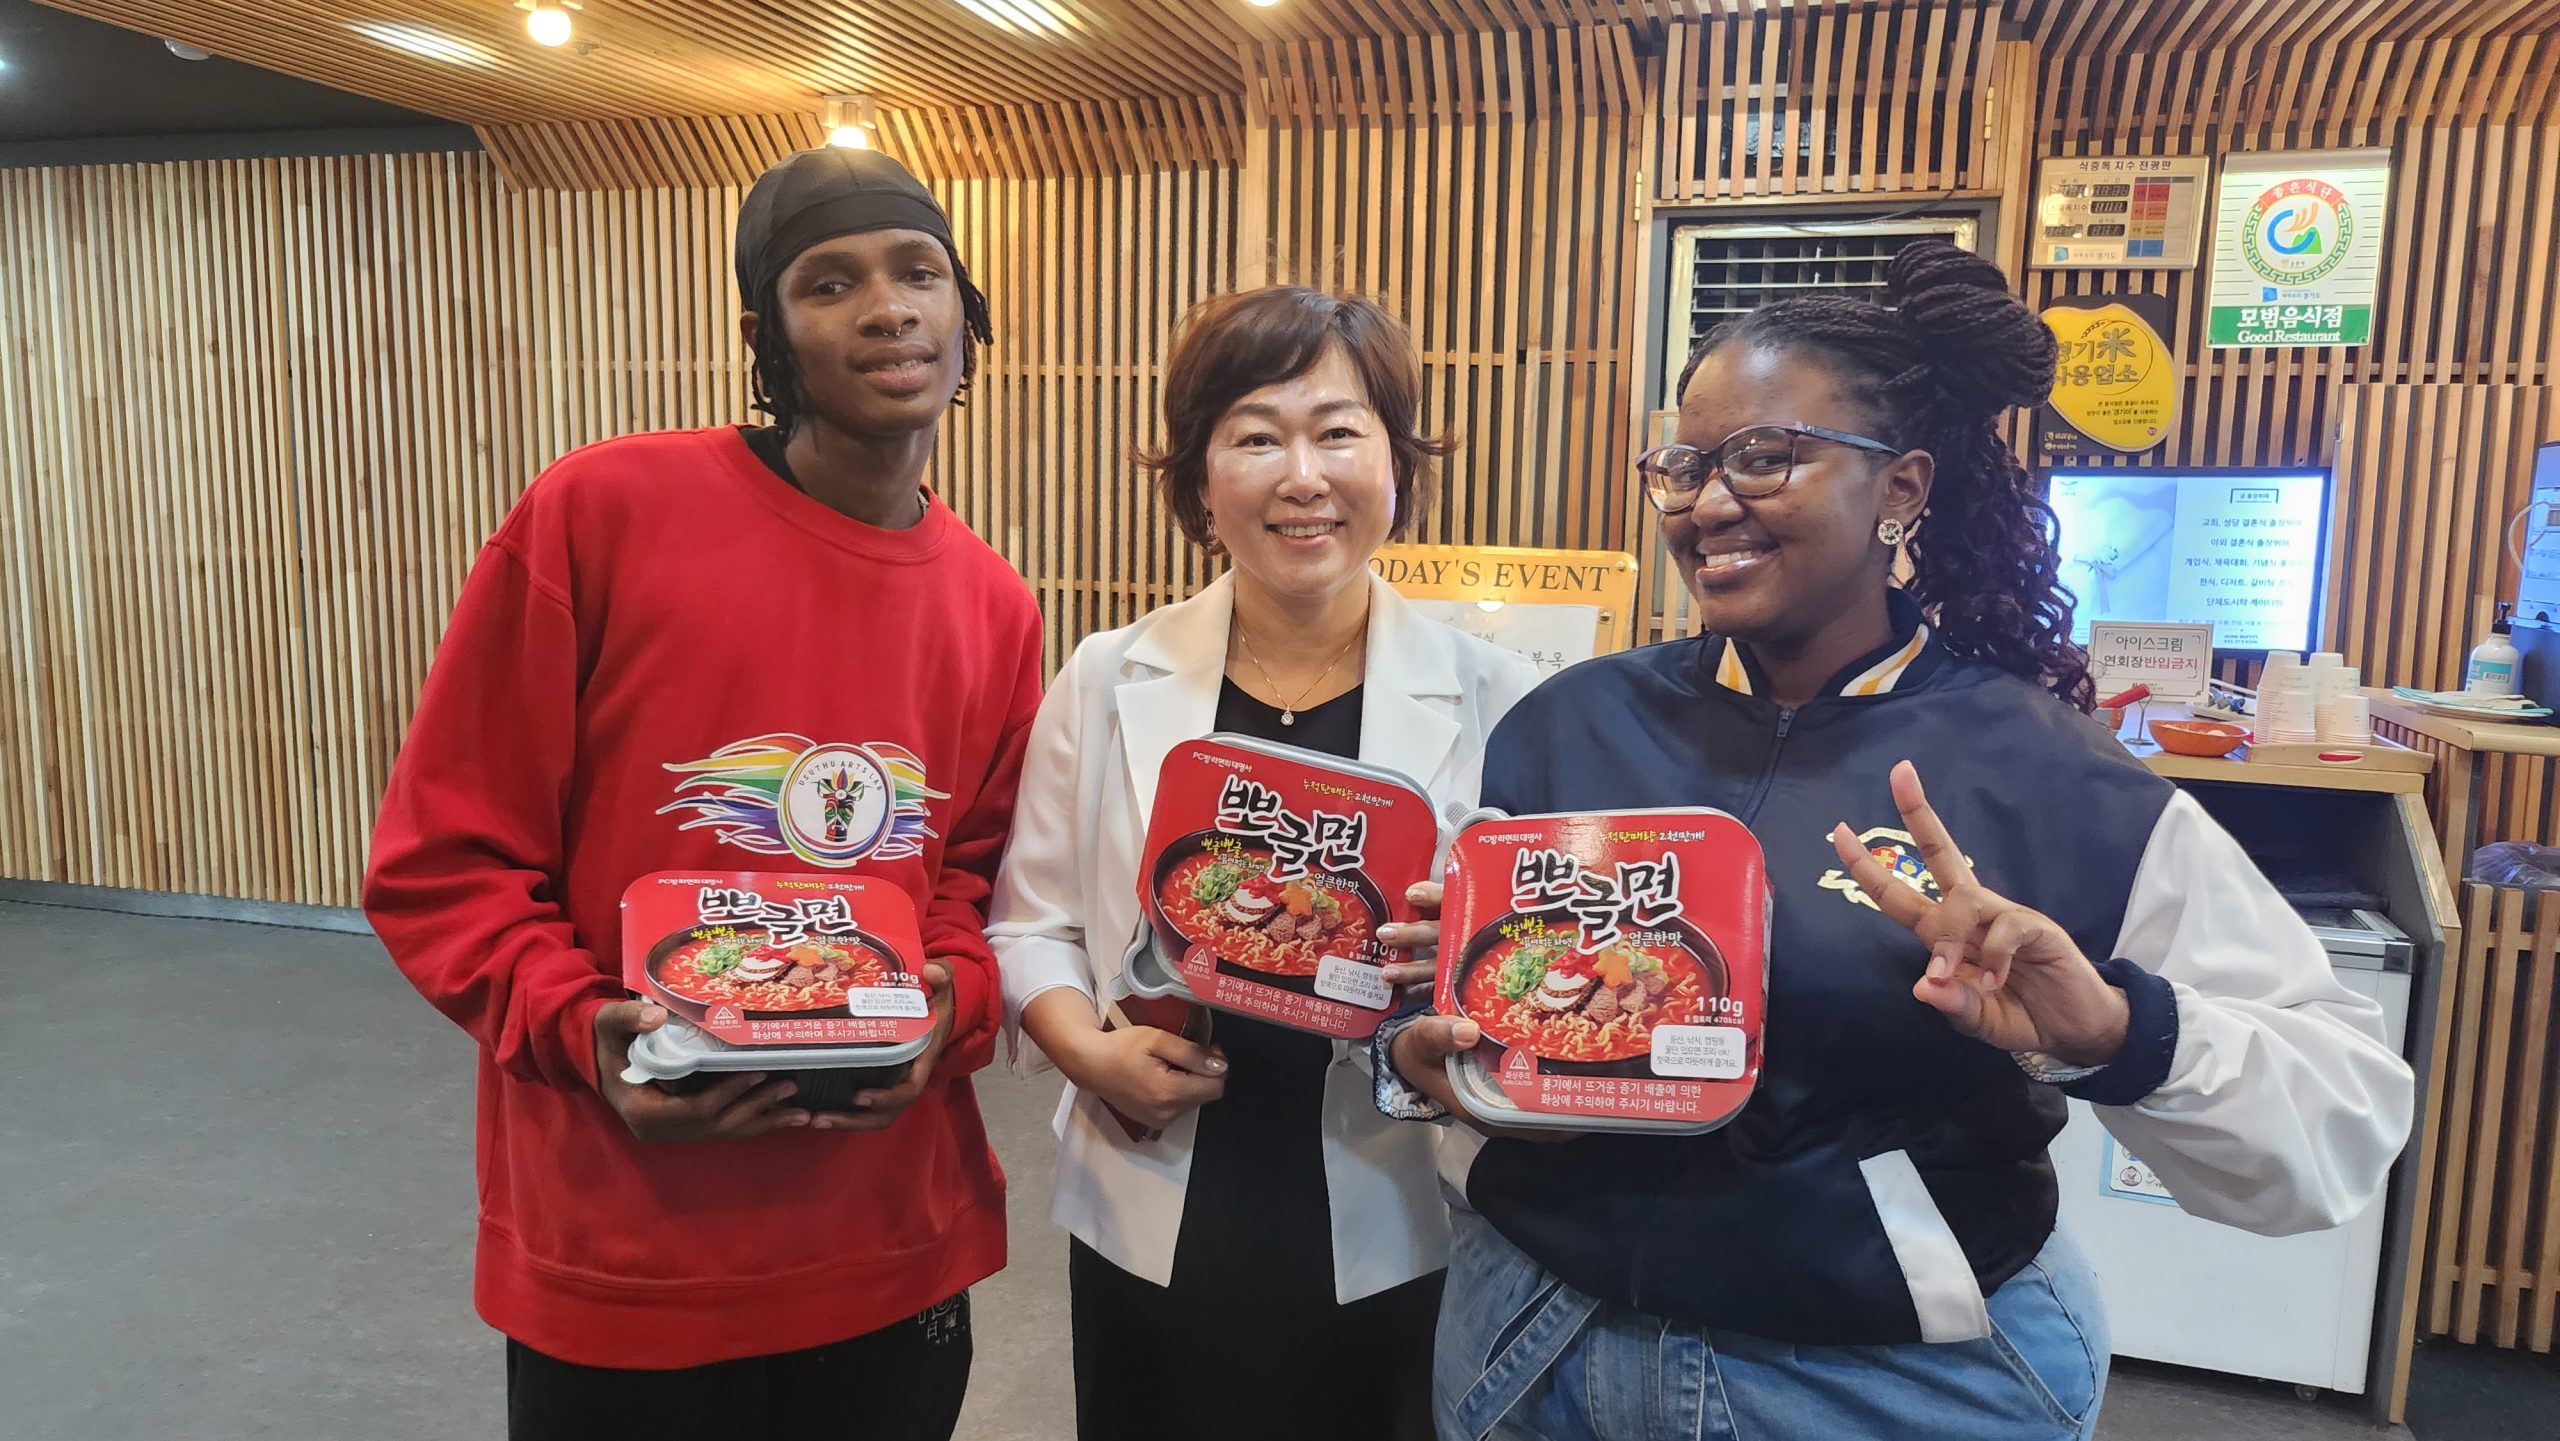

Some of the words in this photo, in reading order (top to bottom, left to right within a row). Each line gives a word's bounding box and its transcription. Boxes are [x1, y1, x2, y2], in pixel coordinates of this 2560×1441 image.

[2080, 161, 2111, 171] 식중독
[2114, 161, 2135, 171] 지수
[2139, 160, 2172, 171] 전광판
[2236, 305, 2344, 330] 모범음식점
[2237, 330, 2274, 343] Good
[2274, 329, 2341, 343] Restaurant
[1368, 557, 1481, 587] ODAY'S
[1493, 562, 1610, 592] EVENT
[2115, 636, 2184, 652] 아이스크림
[798, 760, 836, 787] USUTHU
[840, 761, 868, 774] ARTS
[868, 773, 883, 791] LAB
[1314, 872, 1360, 895] 얼큰한맛
[1628, 930, 1683, 948] 얼큰한맛
[1361, 938, 1399, 961] 110g
[880, 971, 919, 984] 110g
[1217, 977, 1253, 993] 용기에서
[1255, 986, 1282, 1001] 뜨거운
[1284, 994, 1302, 1008] 증기
[1304, 999, 1332, 1015] 배출에
[1335, 1006, 1353, 1020] 의한
[1696, 996, 1744, 1018] 110g
[1215, 989, 1242, 1005] 화상에
[1244, 996, 1280, 1014] 주의하여
[1281, 1005, 1309, 1022] 주시기
[1311, 1012, 1350, 1033] 바랍니다.
[751, 1021, 790, 1030] 용기에서
[793, 1020, 822, 1030] 뜨거운
[826, 1020, 845, 1029] 증기
[848, 1020, 877, 1029] 배출에
[879, 1020, 898, 1029] 의한
[752, 1030, 782, 1040] 화상에
[785, 1030, 824, 1039] 주의하여
[827, 1029, 856, 1038] 주시기
[859, 1029, 900, 1038] 바랍니다.
[1505, 1071, 1531, 1081] 화상주의
[1541, 1078, 1582, 1092] 용기에서
[1585, 1079, 1616, 1095] 뜨거운
[1620, 1081, 1640, 1096] 증기
[1644, 1083, 1676, 1097] 배출에
[1680, 1084, 1701, 1098] 의한
[1541, 1093, 1571, 1107] 화상에
[1575, 1095, 1615, 1110] 주의하여
[1618, 1097, 1650, 1111] 주시기
[1654, 1099, 1700, 1114] 바랍니다.
